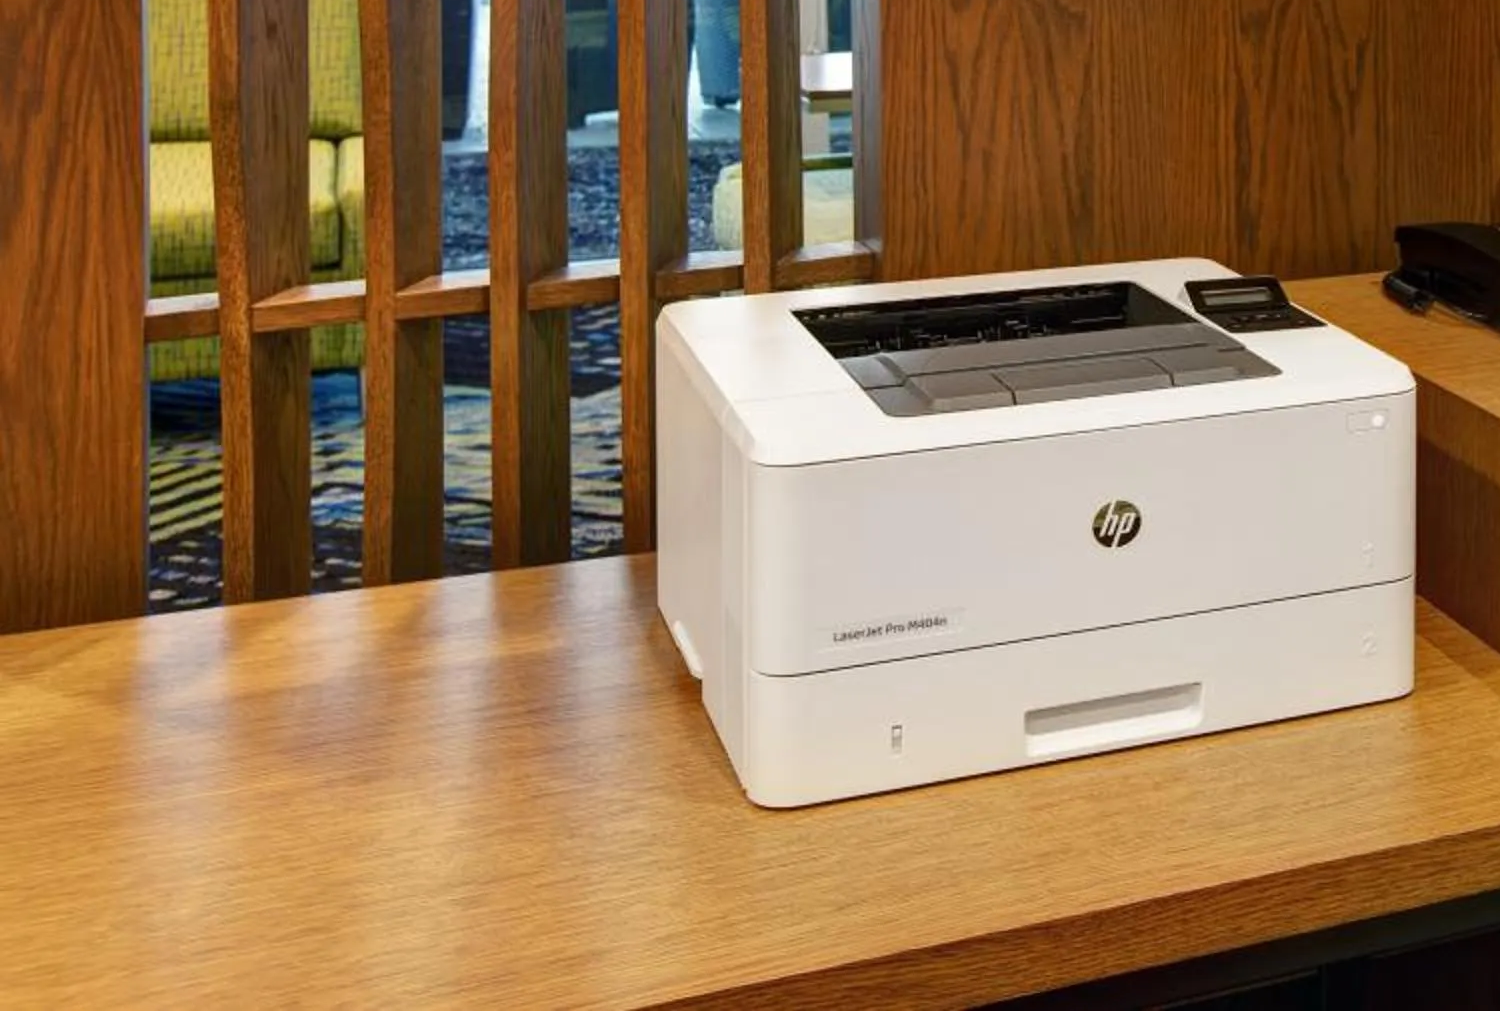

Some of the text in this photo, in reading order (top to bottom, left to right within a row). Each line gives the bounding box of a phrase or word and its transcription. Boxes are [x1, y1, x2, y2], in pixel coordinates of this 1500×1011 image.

[1096, 499, 1139, 549] hp
[833, 626, 882, 642] LaserJet
[885, 622, 905, 635] Pro
